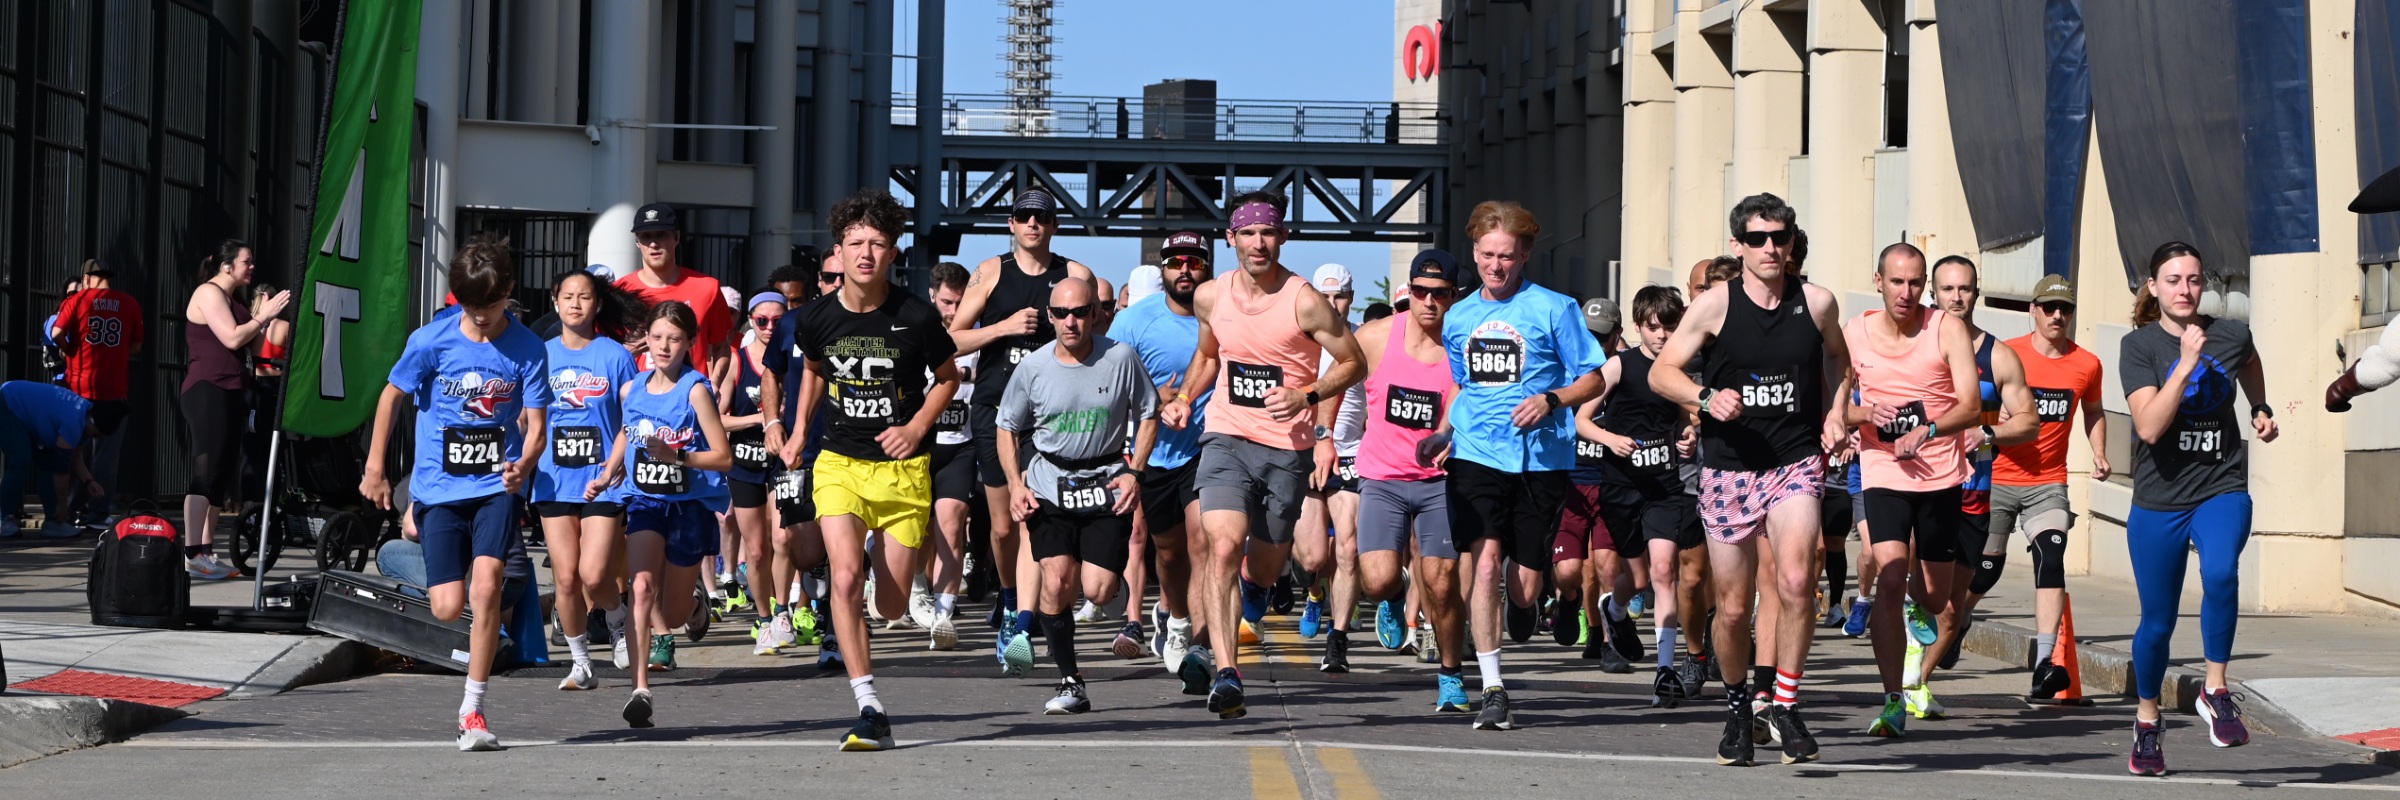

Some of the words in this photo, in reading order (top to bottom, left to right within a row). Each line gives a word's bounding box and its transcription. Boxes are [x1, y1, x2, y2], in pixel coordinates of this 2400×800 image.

[1588, 304, 1601, 316] C
[85, 316, 121, 347] 38
[836, 336, 885, 348] SHATTER
[823, 345, 900, 358] EXPECTATIONS
[1472, 352, 1517, 373] 5864
[828, 355, 894, 380] XC
[1233, 376, 1277, 399] 5337
[1742, 382, 1794, 407] 5632
[843, 396, 893, 418] 5223
[1390, 399, 1433, 421] 5375
[557, 438, 594, 457] 5317
[2178, 429, 2222, 452] 5731
[448, 441, 499, 464] 5224
[735, 443, 767, 461] 5713
[1631, 445, 1670, 467] 5183
[636, 462, 683, 485] 5225
[1063, 486, 1107, 509] 5150
[138, 523, 164, 531] HUSKY
